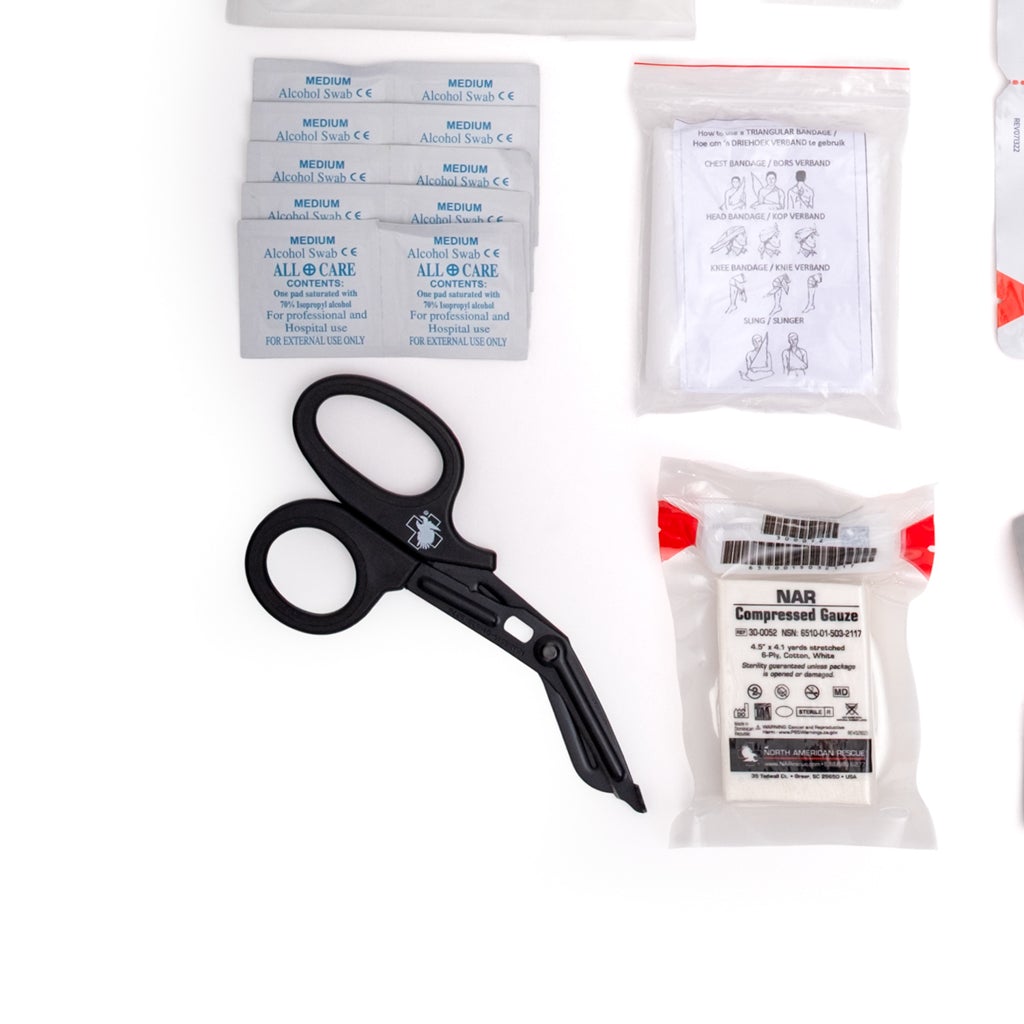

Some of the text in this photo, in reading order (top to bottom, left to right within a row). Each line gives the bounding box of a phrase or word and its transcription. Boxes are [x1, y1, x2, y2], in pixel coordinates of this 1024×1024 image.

[306, 77, 351, 85] MEDIUM
[448, 79, 492, 88] MEDIUM
[279, 88, 352, 99] Alcohol Swab
[422, 91, 495, 102] Alcohol Swab
[303, 119, 348, 127] MEDIUM
[290, 236, 335, 244] MEDIUM
[264, 248, 337, 259] Alcohol Swab
[274, 263, 356, 276] ALL CARE
[711, 264, 830, 272] KNEE BANDAGE KNIE VERBAND
[287, 279, 344, 287] CONTENTS:
[290, 290, 303, 299] pad
[267, 310, 367, 321] For professional and
[744, 317, 765, 325] SLING
[285, 323, 327, 333] Hospital
[266, 336, 365, 345] FOR EXTERNAL USE ONLY
[776, 590, 816, 603] NAR
[736, 607, 858, 623] Compressed Gauze
[749, 628, 777, 636] 30-0052
[801, 629, 861, 637] 6510-01-503-2117
